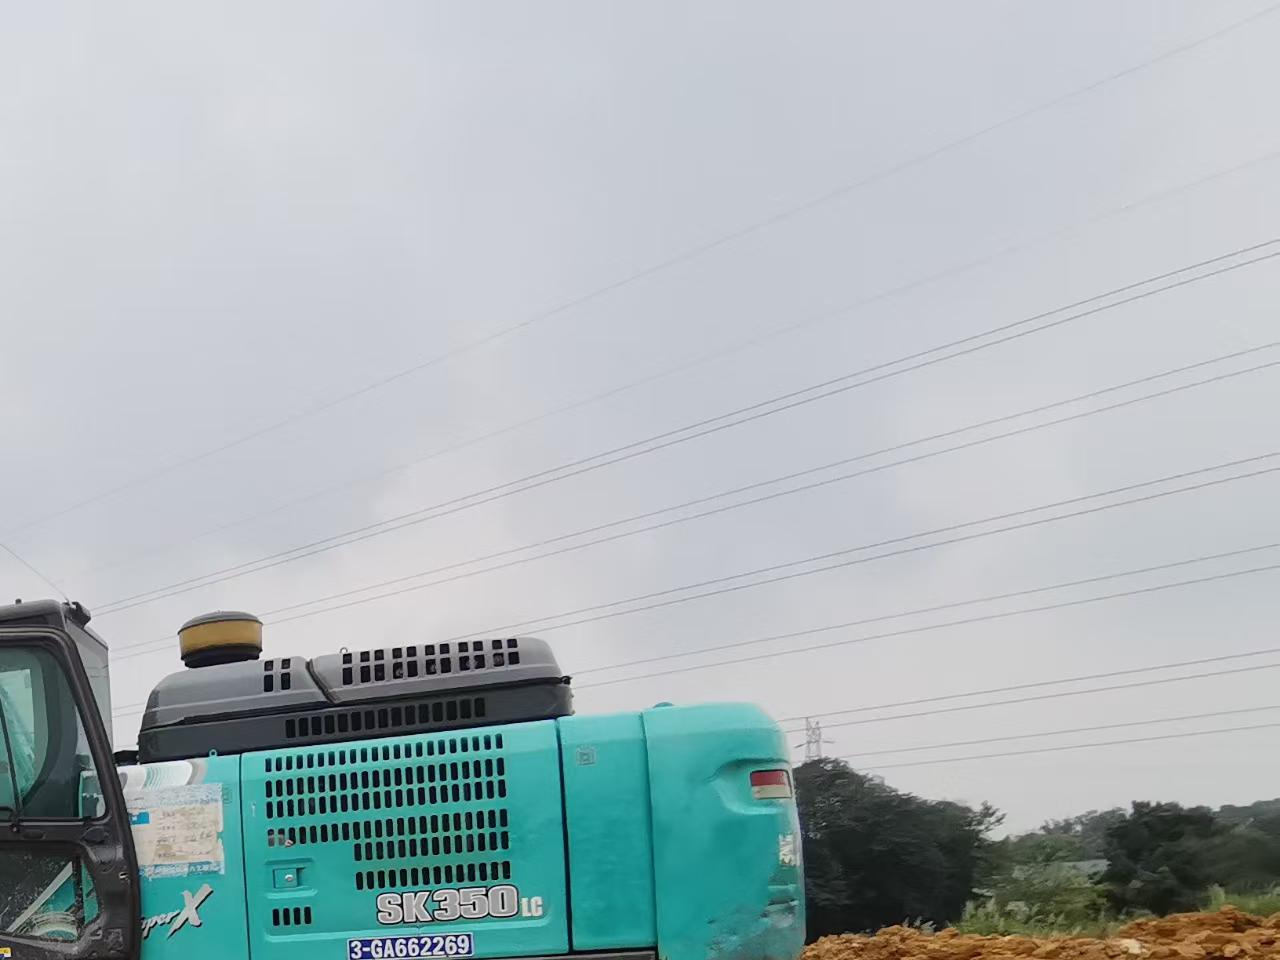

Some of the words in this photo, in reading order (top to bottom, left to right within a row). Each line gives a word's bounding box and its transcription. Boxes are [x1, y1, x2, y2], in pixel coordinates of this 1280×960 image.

[377, 885, 519, 924] SK350
[521, 896, 544, 917] LC
[350, 934, 470, 960] 3-GA662269
